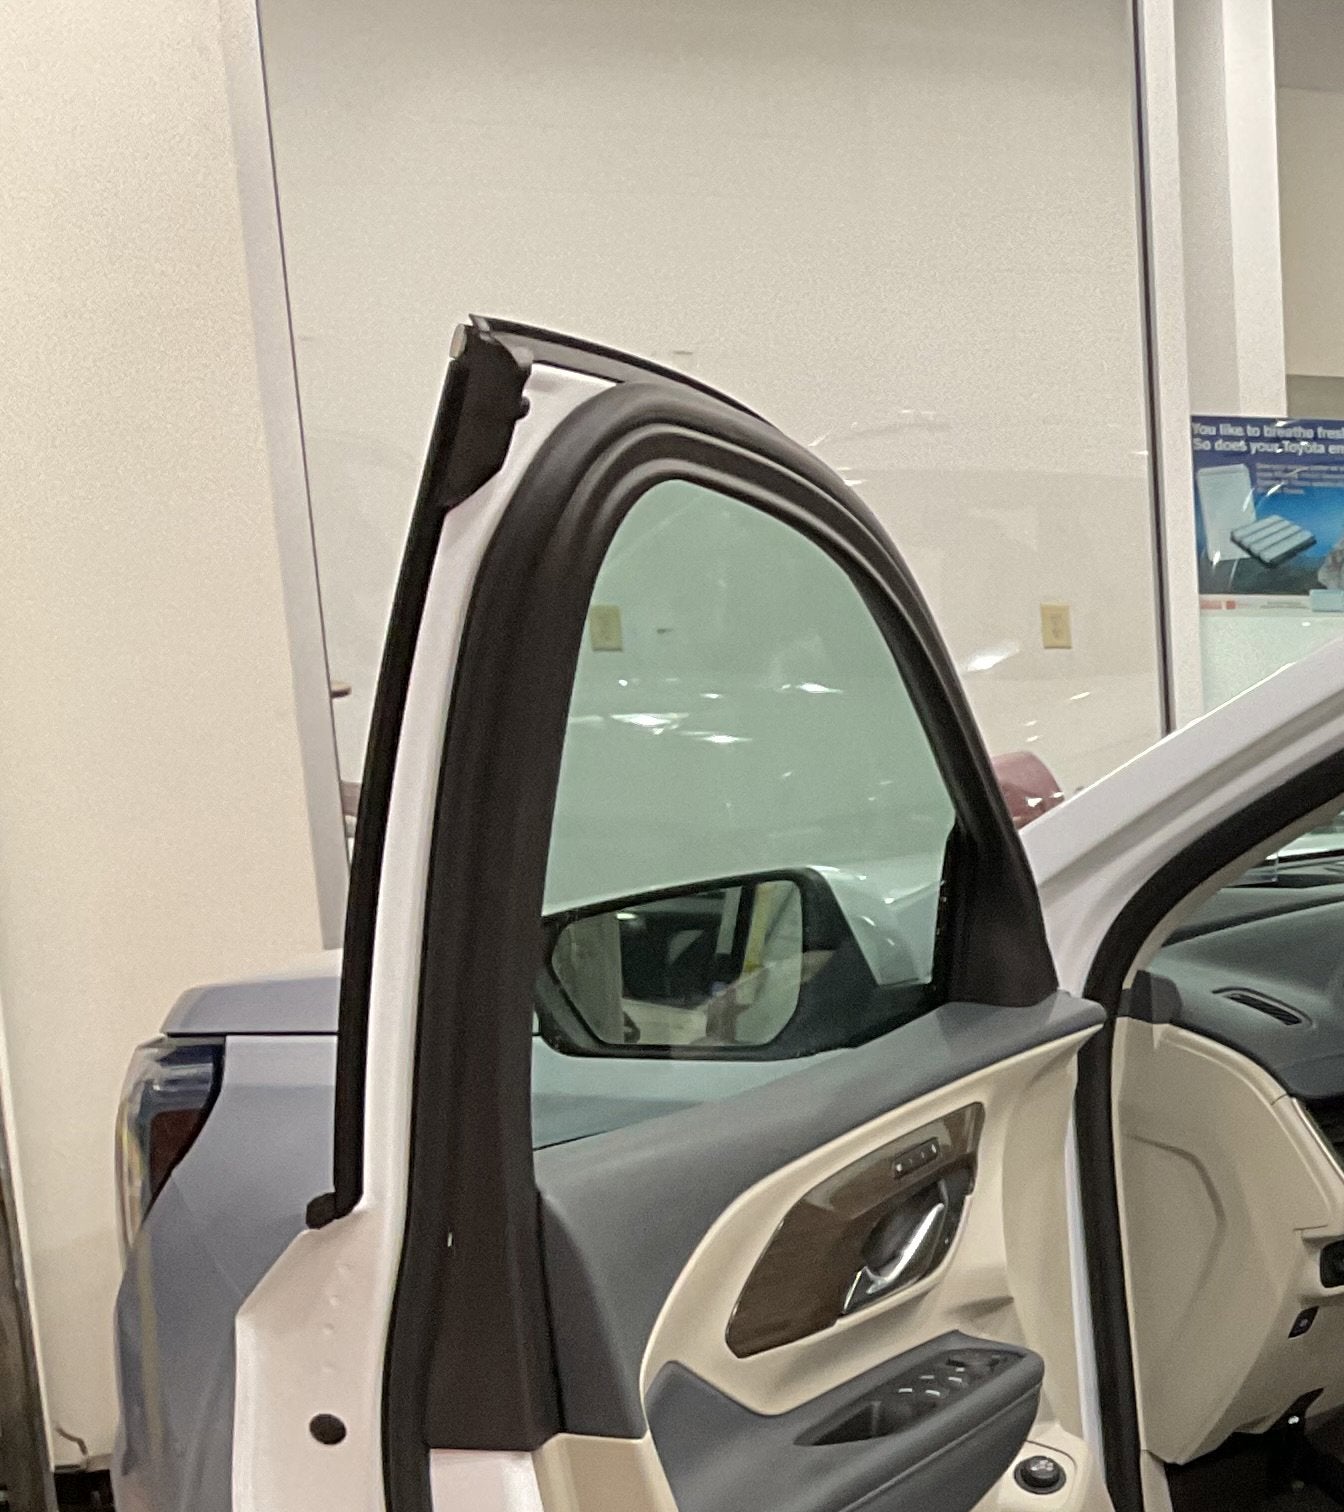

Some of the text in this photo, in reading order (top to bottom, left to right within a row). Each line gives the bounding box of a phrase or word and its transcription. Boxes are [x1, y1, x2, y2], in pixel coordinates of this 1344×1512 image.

[1191, 423, 1216, 436] You
[1219, 423, 1244, 437] like
[1246, 424, 1260, 437] to
[1263, 424, 1314, 439] breathe
[1192, 438, 1211, 451] So
[1214, 439, 1248, 452] does
[1282, 440, 1325, 456] Toyota
